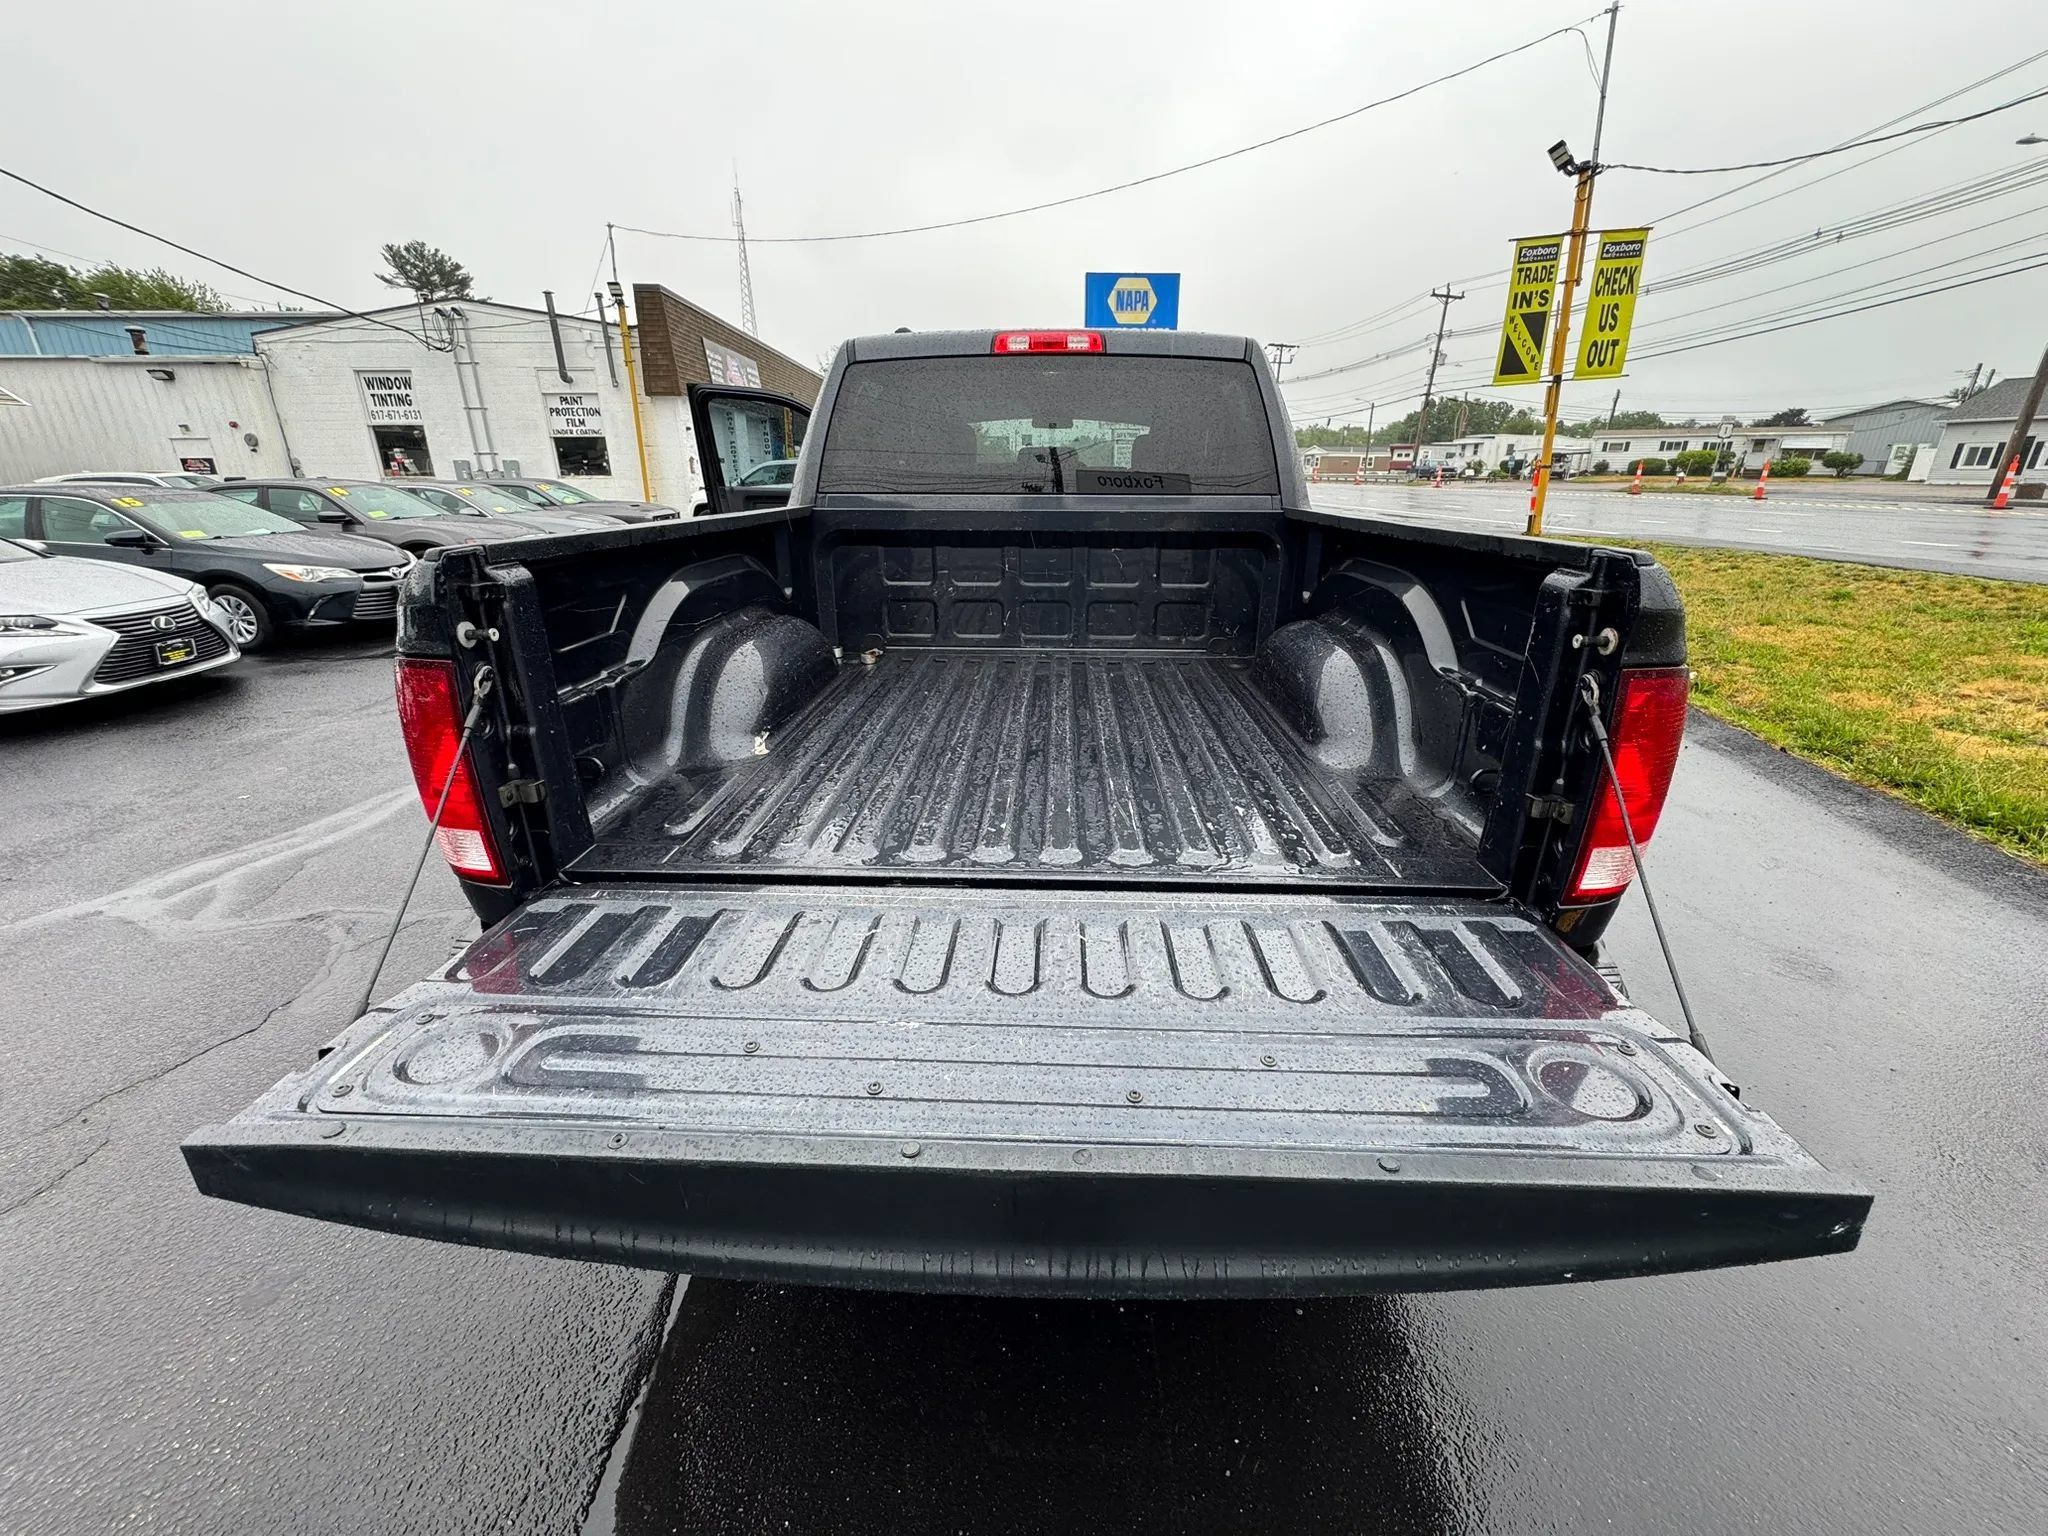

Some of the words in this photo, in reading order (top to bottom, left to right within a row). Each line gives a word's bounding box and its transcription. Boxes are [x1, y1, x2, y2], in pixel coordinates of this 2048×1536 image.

[1521, 245, 1558, 258] Foxboro
[1603, 241, 1642, 254] Foxboro
[1516, 264, 1556, 286] TRADE
[1594, 265, 1639, 298] CHECK
[1116, 290, 1149, 312] NAPA
[1511, 288, 1550, 310] IN'S
[1598, 302, 1620, 333] US
[1508, 315, 1540, 371] WELCOME
[1586, 338, 1621, 369] OUT
[362, 376, 413, 391] WINDOW
[370, 393, 413, 407] TINTING
[559, 396, 583, 406] PAINT
[370, 409, 422, 420] 617-671-6131
[549, 407, 602, 417] PROTECTION
[565, 418, 587, 428] FILM
[552, 428, 574, 436] UNDER
[575, 428, 603, 436] COATING
[760, 418, 771, 456] WINDOW
[110, 496, 145, 509] 15
